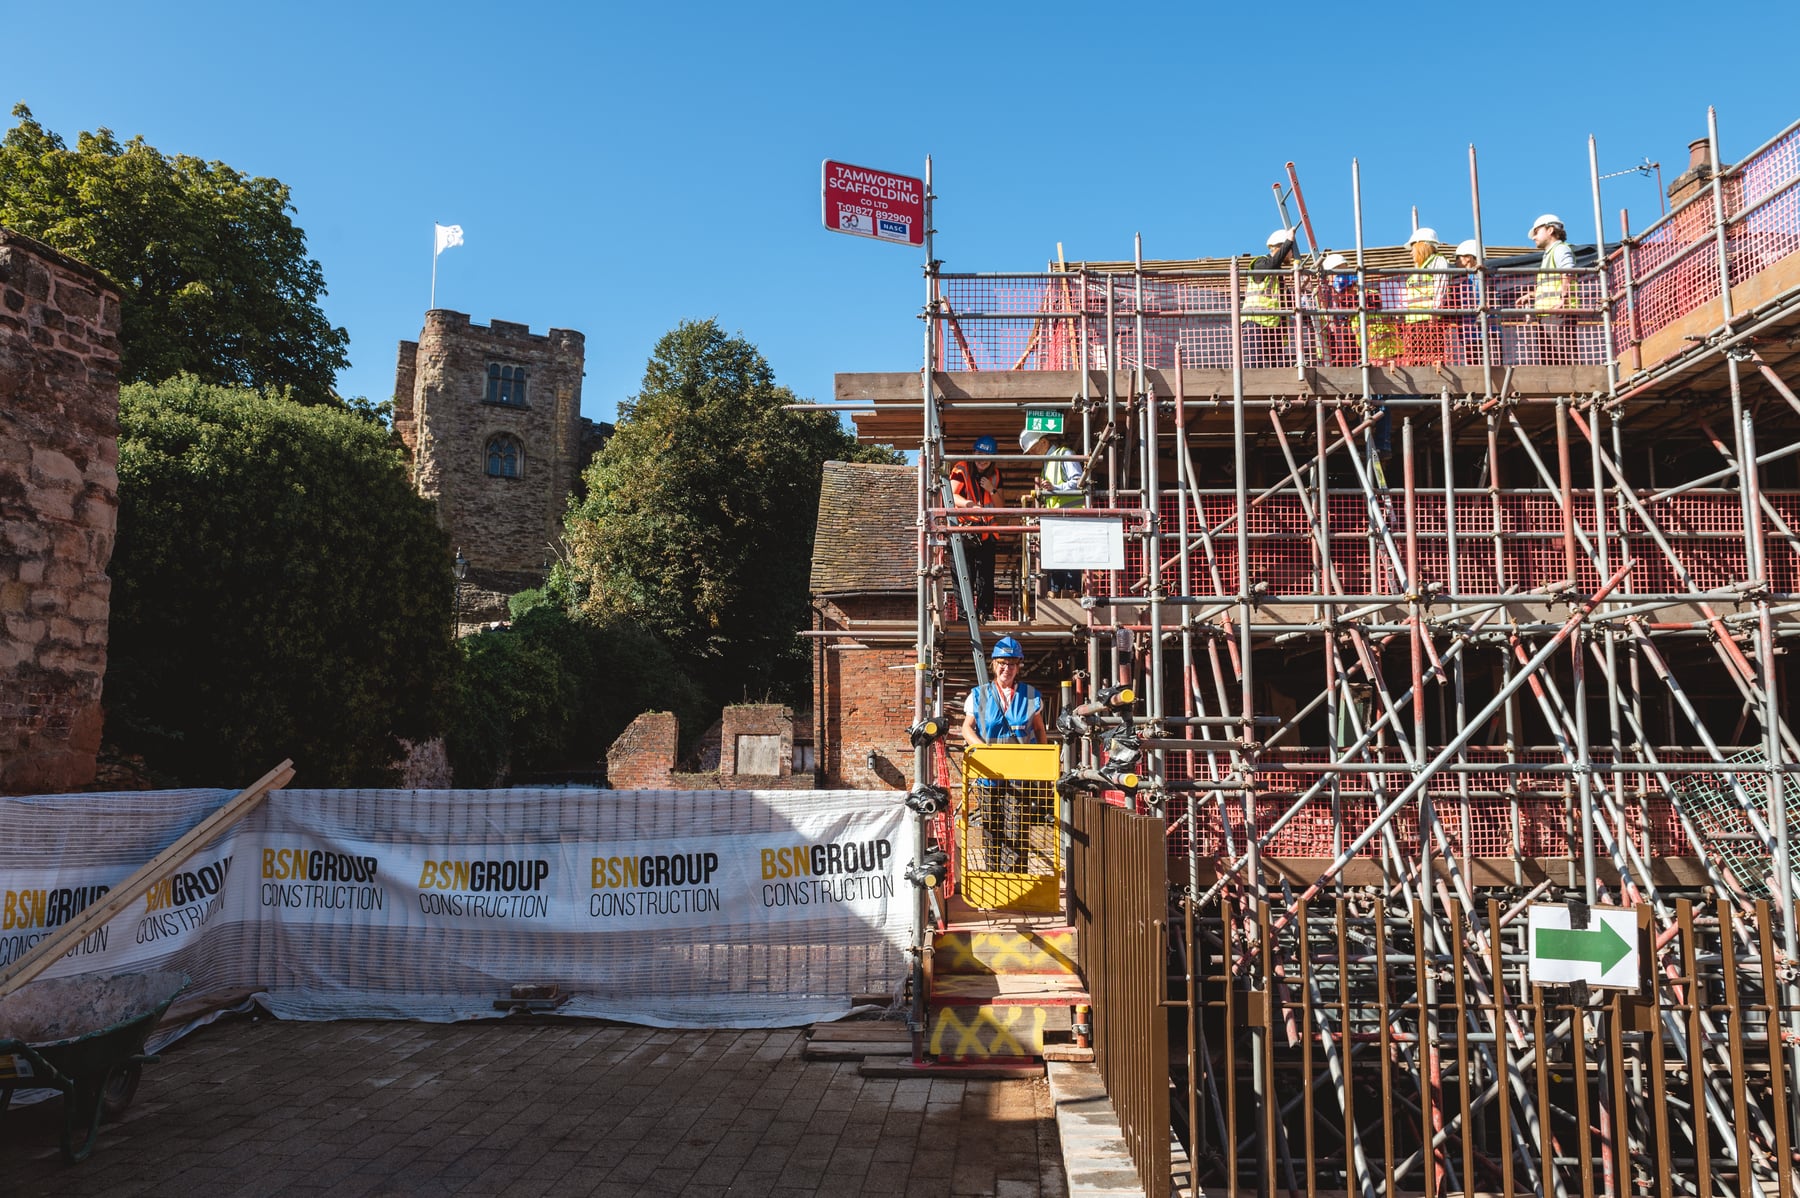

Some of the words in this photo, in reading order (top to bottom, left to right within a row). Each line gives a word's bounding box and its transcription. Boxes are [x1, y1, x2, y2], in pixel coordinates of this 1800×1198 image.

[829, 177, 919, 205] SCAFFOLDING
[835, 166, 912, 192] TAMWORTH
[836, 201, 873, 217] T:01827
[875, 210, 912, 225] 892900
[860, 198, 872, 207] CO
[873, 201, 888, 210] LTD
[883, 223, 903, 233] NASC
[261, 848, 378, 883] BSNGROUP
[591, 852, 719, 889] BSNGROUP
[760, 839, 891, 880] BSNGROUP
[418, 859, 549, 892] BSNGROUP
[262, 883, 383, 911] CONSTRUCTION
[418, 893, 549, 918] CONSTRUCTION
[590, 888, 720, 917] CONSTRUCTION
[762, 875, 895, 908] CONSTRUCTION
